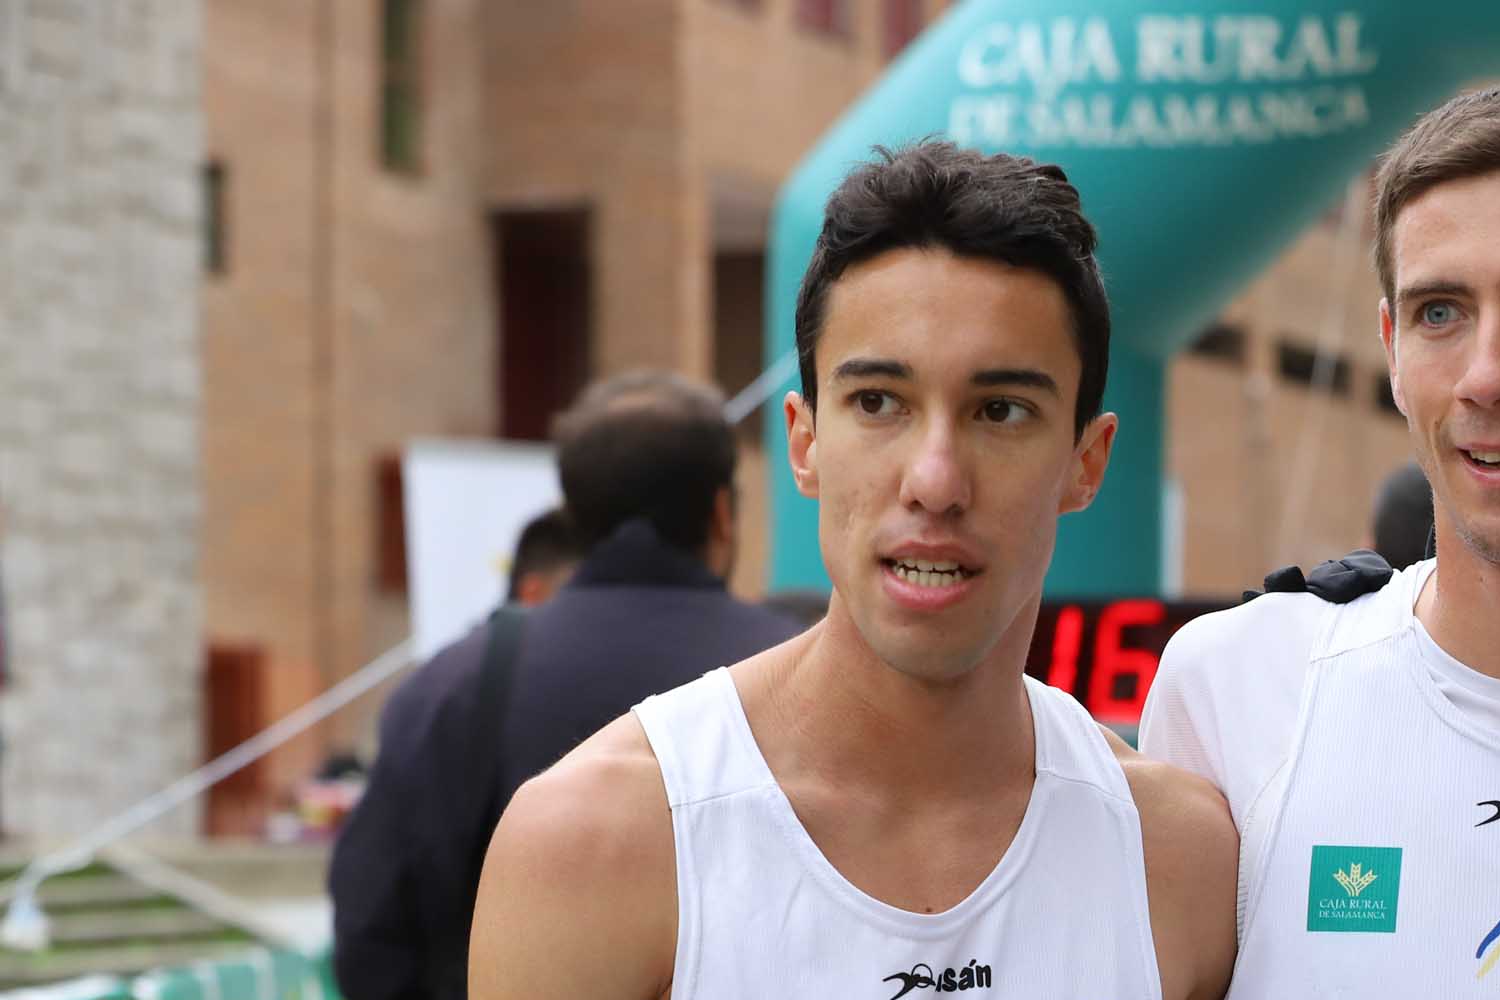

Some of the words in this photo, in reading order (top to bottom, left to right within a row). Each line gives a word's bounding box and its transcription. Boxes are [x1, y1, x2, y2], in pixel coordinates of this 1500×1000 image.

[958, 15, 1119, 97] CAJA
[1137, 12, 1378, 81] RURAL
[949, 95, 1017, 143] DE
[1025, 86, 1370, 147] SALAMANCA
[1320, 899, 1346, 910] CAJA
[1350, 899, 1388, 909] RURAL
[1320, 911, 1329, 919] DE
[1332, 911, 1385, 920] SALAMANCA
[935, 959, 991, 992] sán
